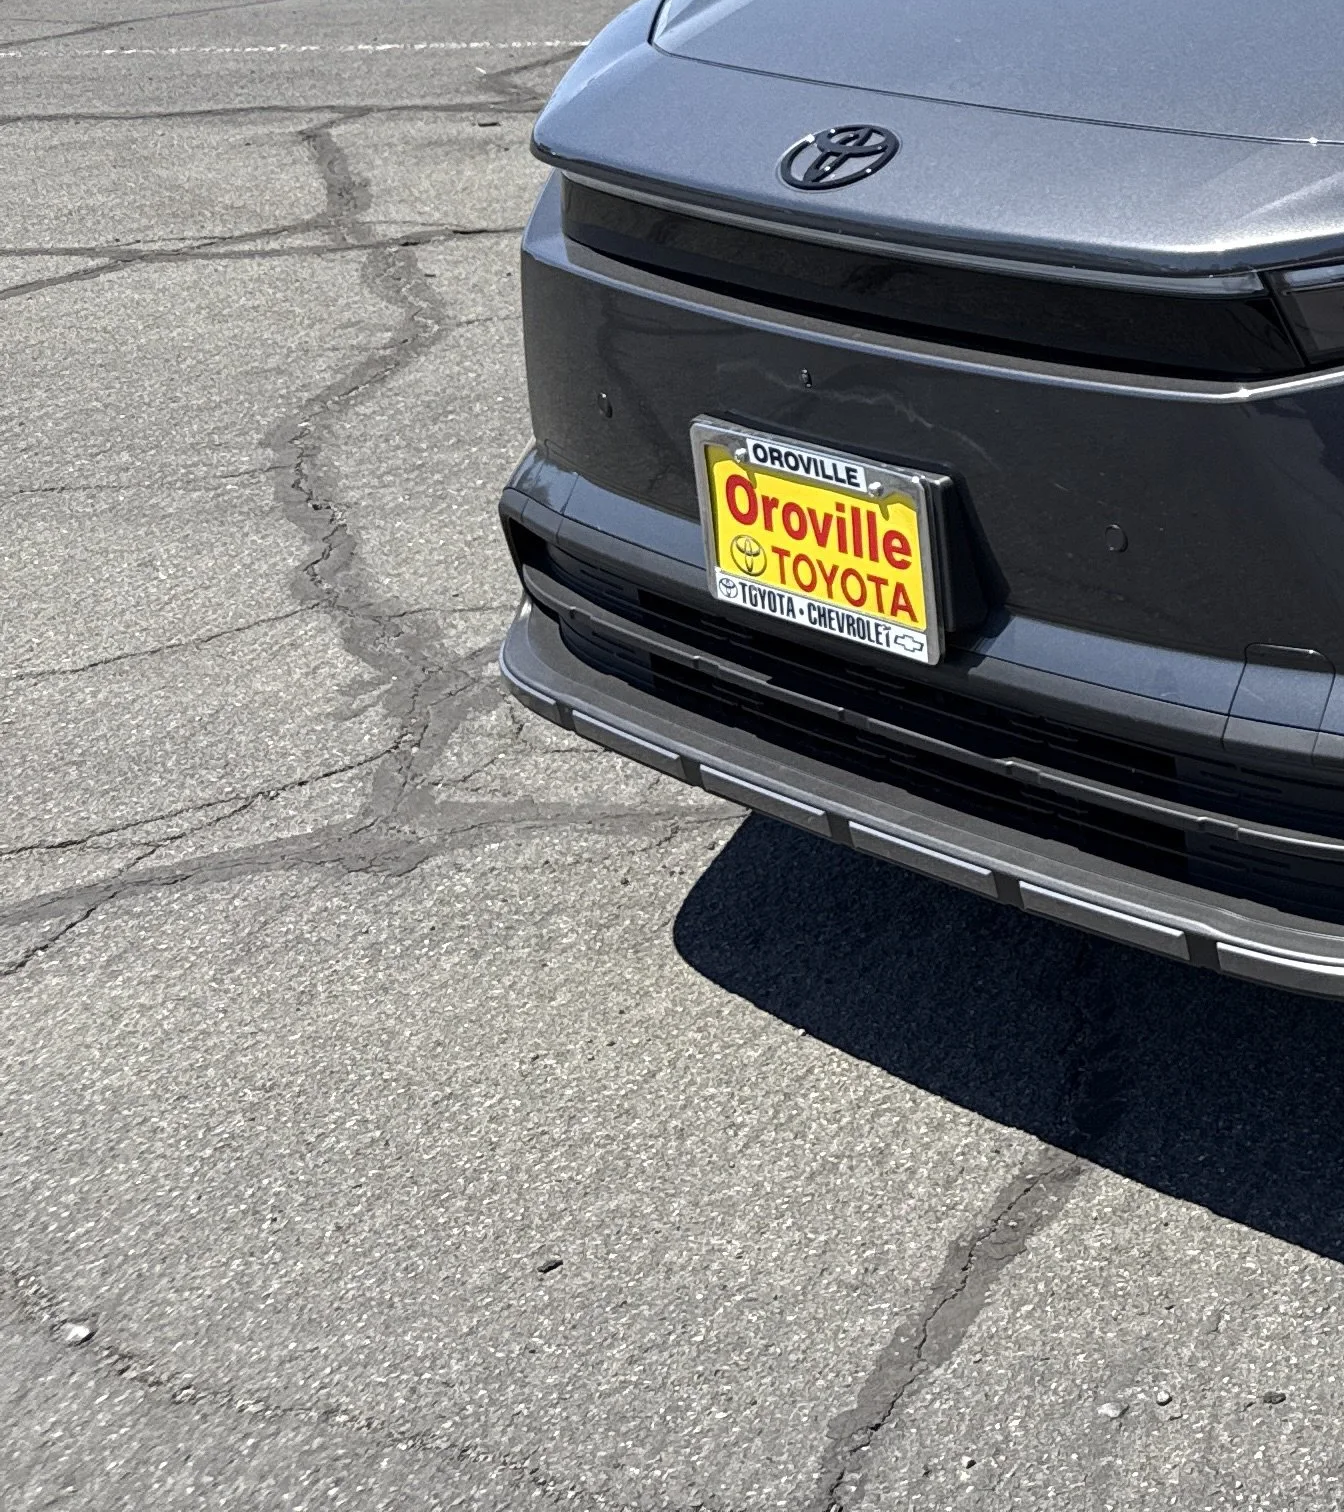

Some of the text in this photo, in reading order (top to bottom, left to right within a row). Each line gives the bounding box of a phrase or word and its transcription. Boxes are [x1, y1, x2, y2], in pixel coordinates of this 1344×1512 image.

[752, 442, 861, 488] OROVILLE
[725, 473, 912, 570] Oroville
[738, 581, 892, 648] TOYOTA CHEVROLET
[771, 545, 918, 623] TOYOTA
